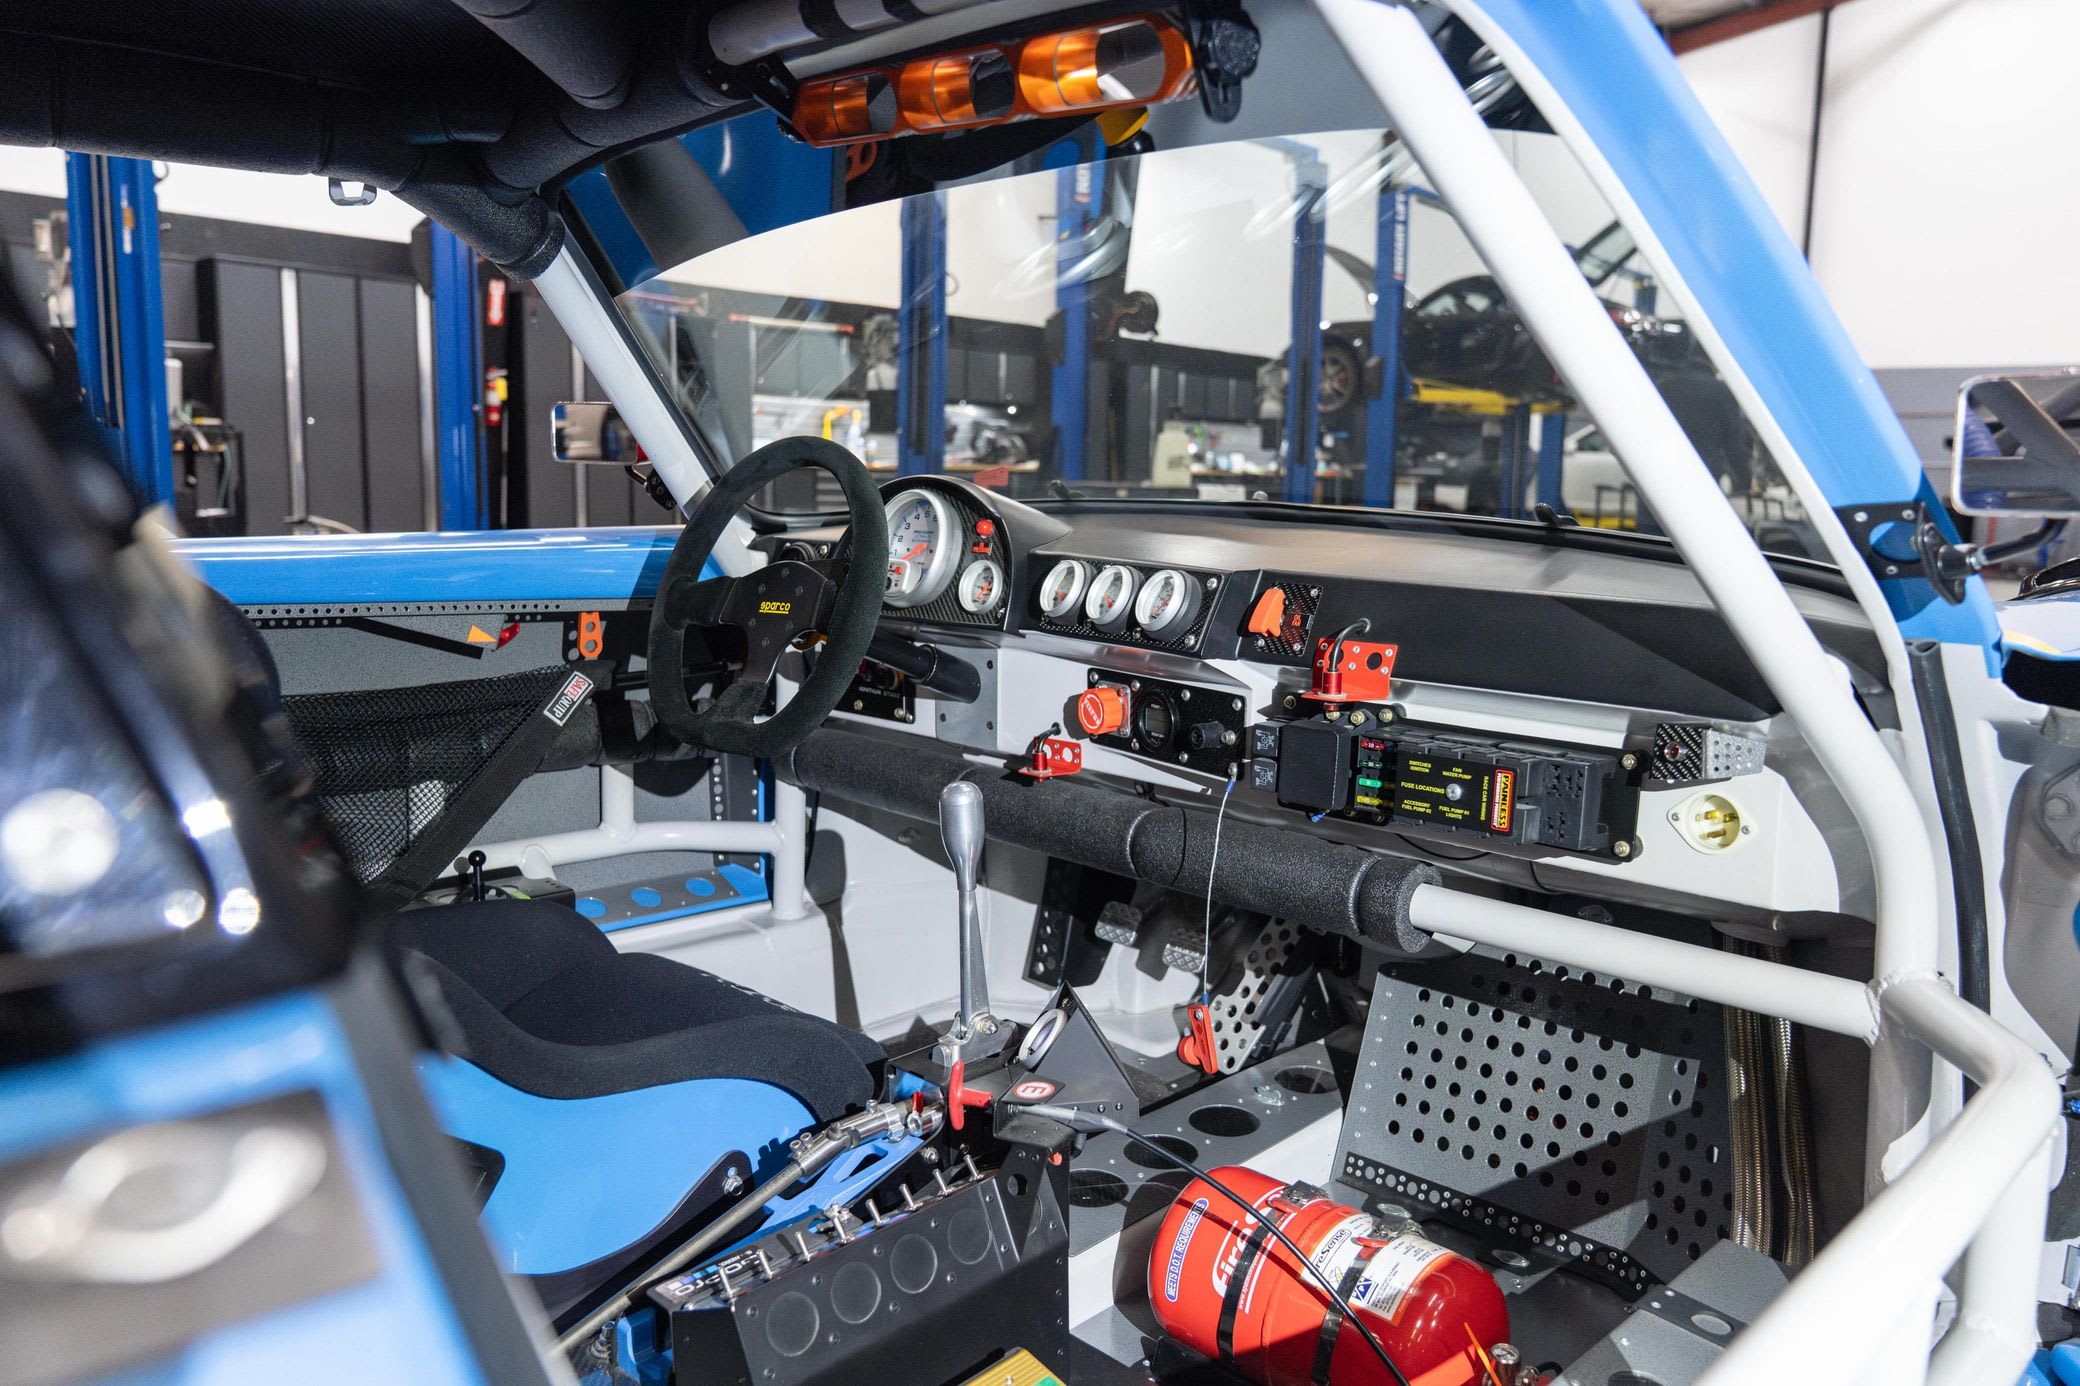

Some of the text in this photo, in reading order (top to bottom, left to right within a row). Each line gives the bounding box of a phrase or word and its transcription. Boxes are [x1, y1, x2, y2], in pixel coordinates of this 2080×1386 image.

[760, 601, 791, 614] sparco
[1409, 760, 1431, 768] SWITCHES
[1415, 784, 1445, 794] LOCATIONS
[1404, 800, 1431, 808] ACCESSORY
[1499, 775, 1510, 826] PAINLESS
[1167, 1274, 1178, 1296] MEETS
[1175, 1200, 1206, 1252] REQUIREMENTS
[1315, 1228, 1347, 1271] reSense
